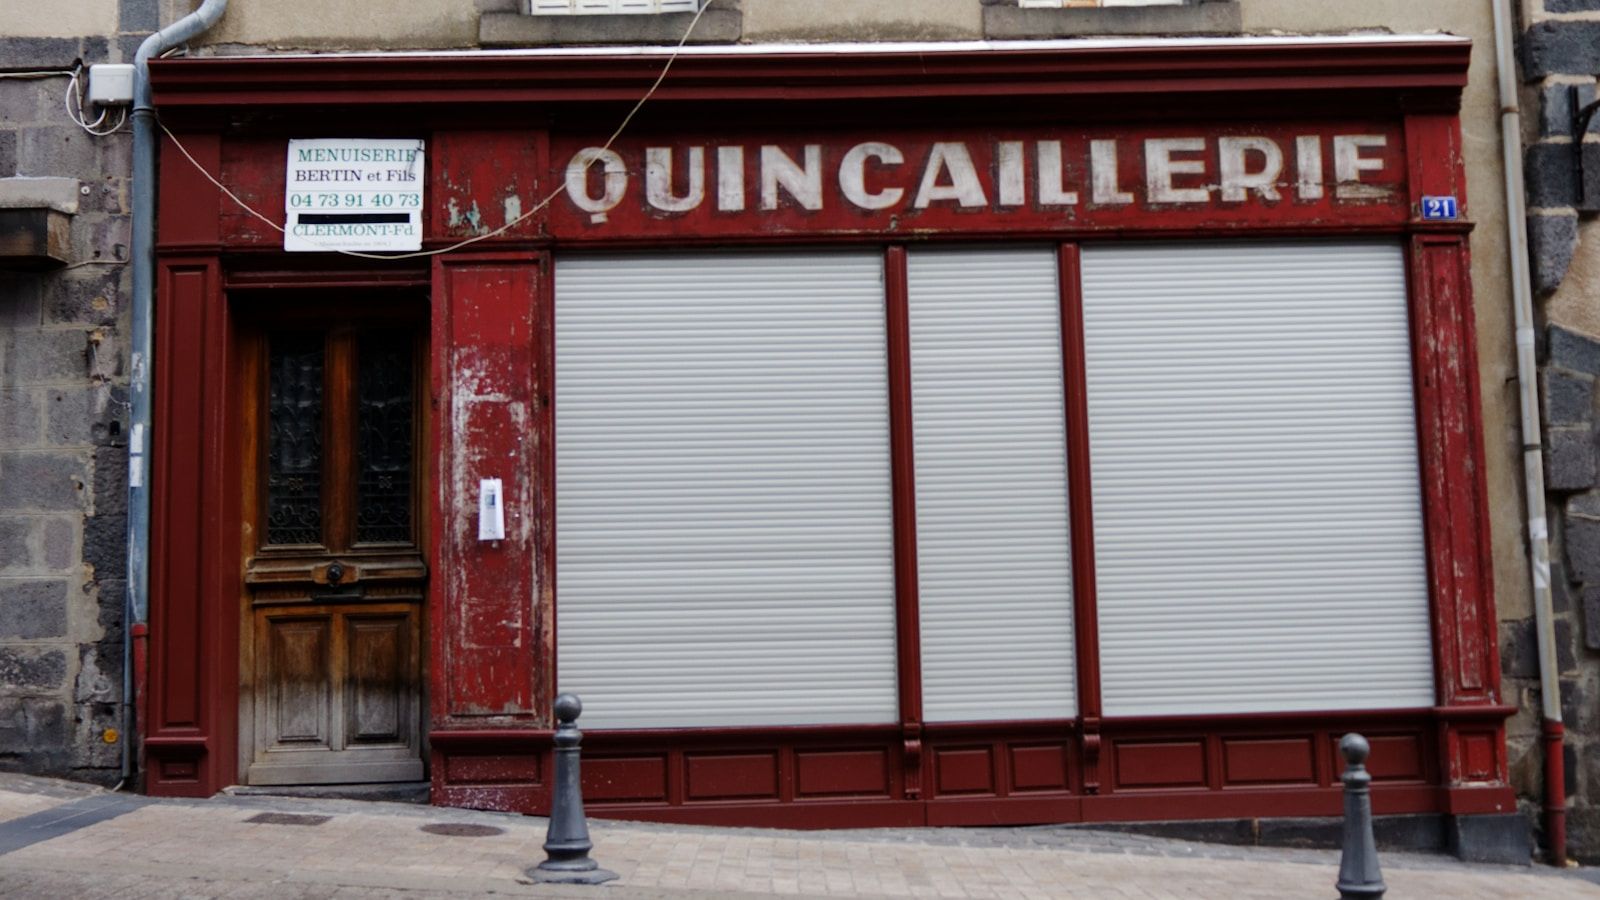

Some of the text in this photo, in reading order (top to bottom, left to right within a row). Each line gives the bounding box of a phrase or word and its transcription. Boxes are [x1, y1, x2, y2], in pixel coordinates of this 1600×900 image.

[298, 149, 417, 162] MENUISERIE
[295, 169, 416, 182] BERTIN et Fils
[565, 133, 1390, 224] QUINCAILLERIE
[290, 193, 420, 207] 04 73 91 40 73
[1428, 199, 1451, 217] 21
[292, 224, 414, 237] CLERMONT-Fd
